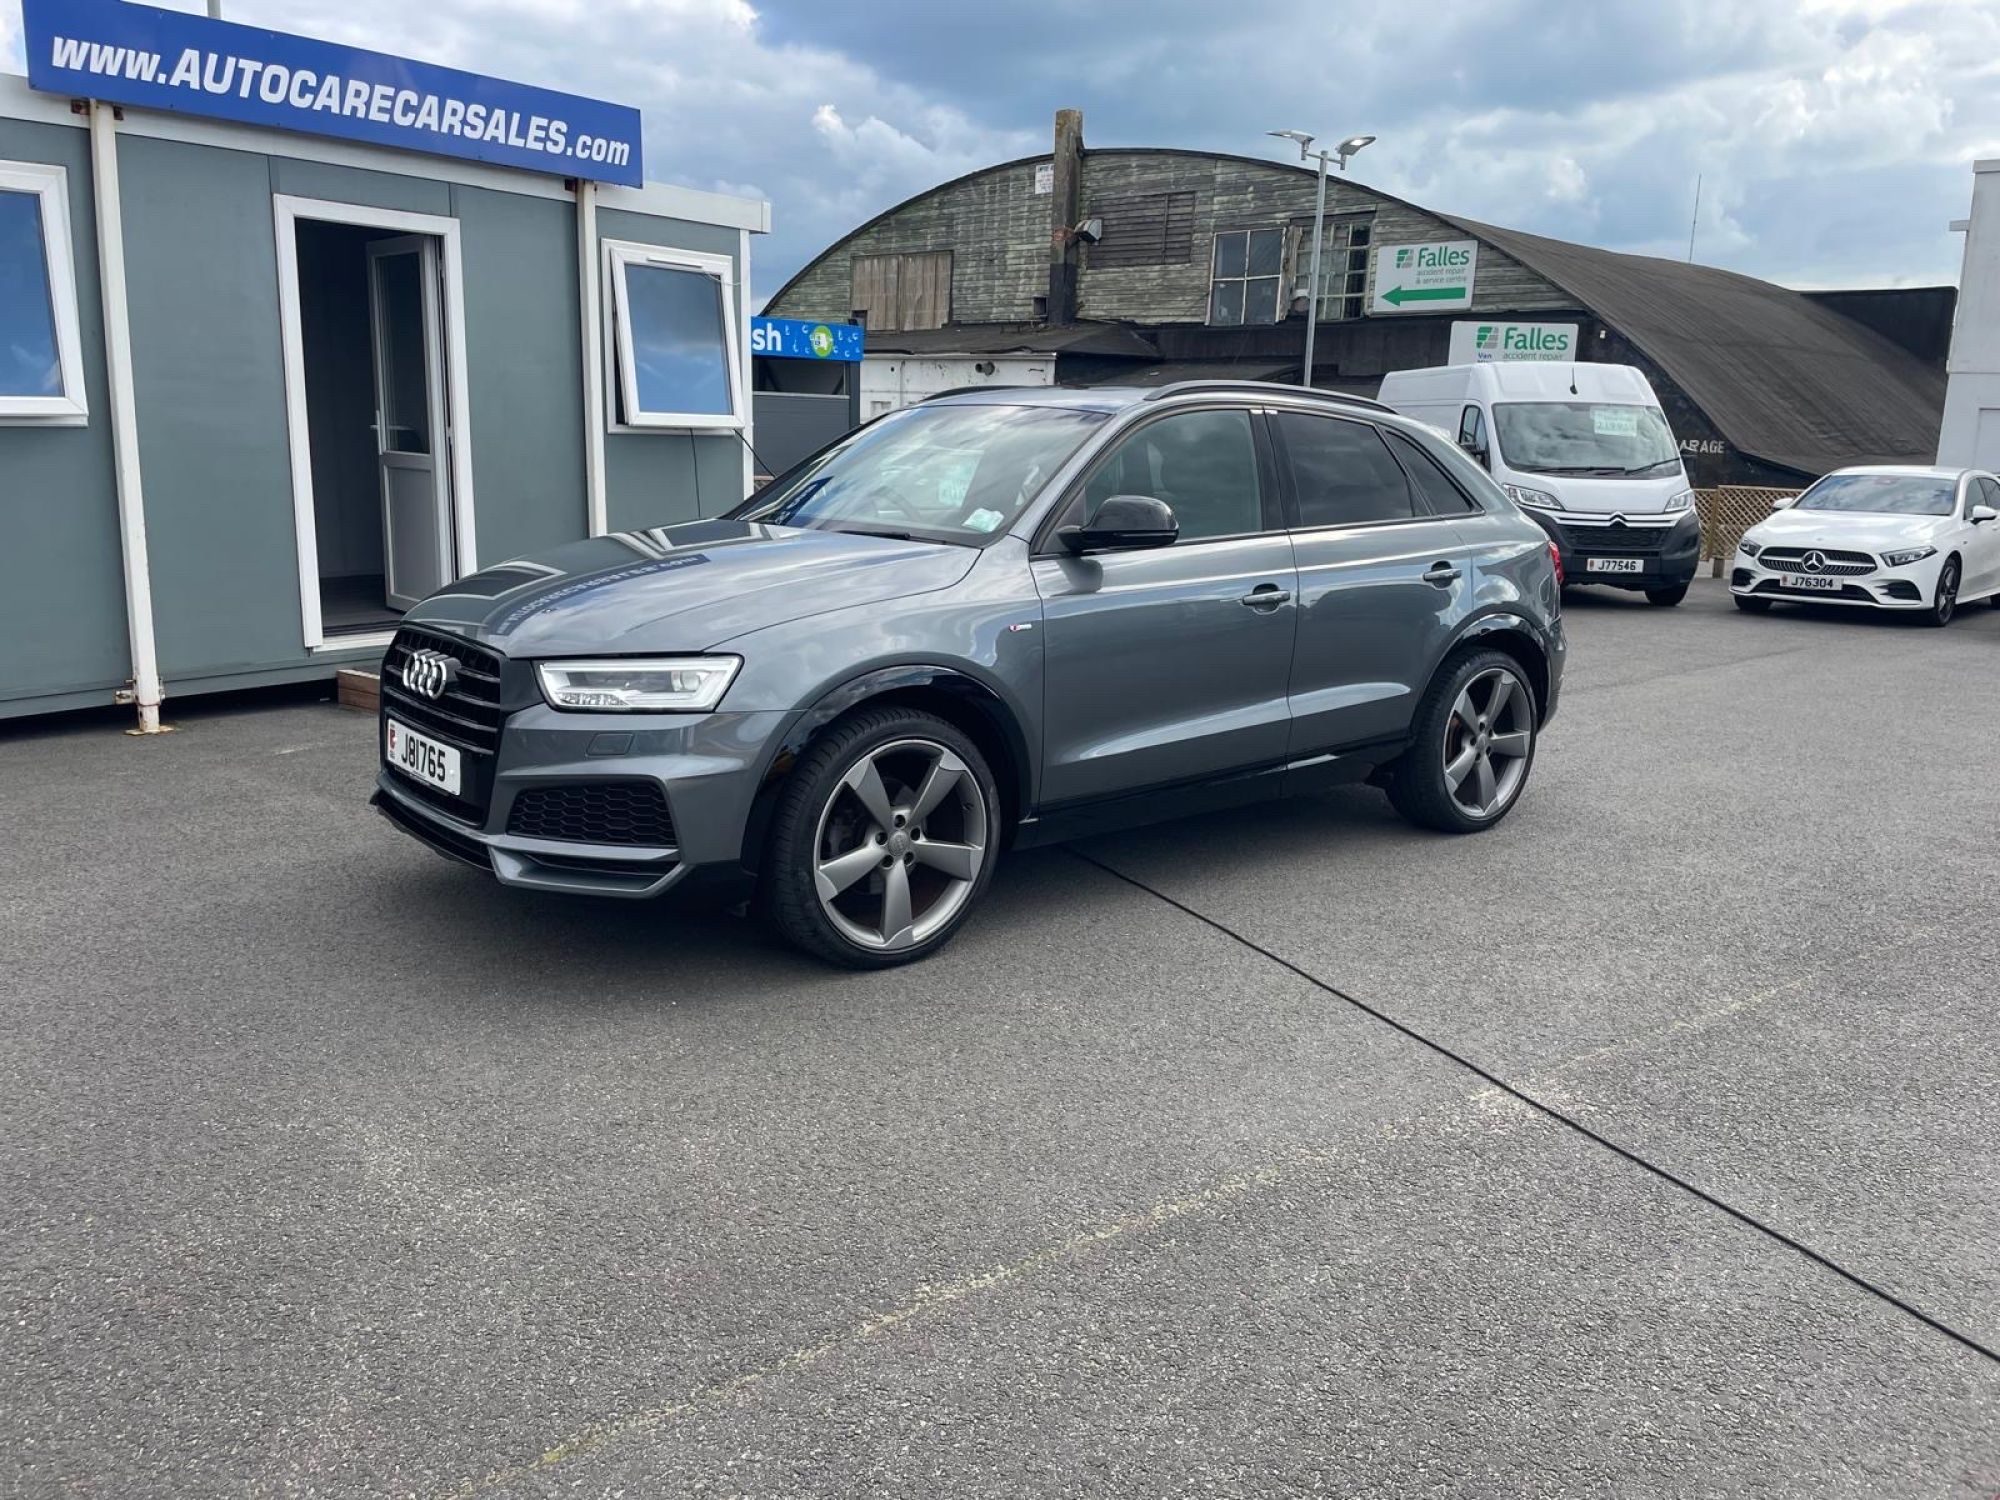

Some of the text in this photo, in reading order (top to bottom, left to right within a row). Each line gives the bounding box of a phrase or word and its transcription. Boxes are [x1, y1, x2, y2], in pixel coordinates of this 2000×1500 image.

[51, 36, 631, 167] www.AUTOCARECARSALES.com
[1418, 246, 1470, 267] Falles
[1504, 327, 1569, 351] Falles
[1503, 352, 1563, 362] accident repair
[1677, 440, 1725, 454] ARAGE
[1598, 560, 1637, 571] J77546
[1791, 576, 1833, 588] J76304
[401, 733, 446, 782] J81765
